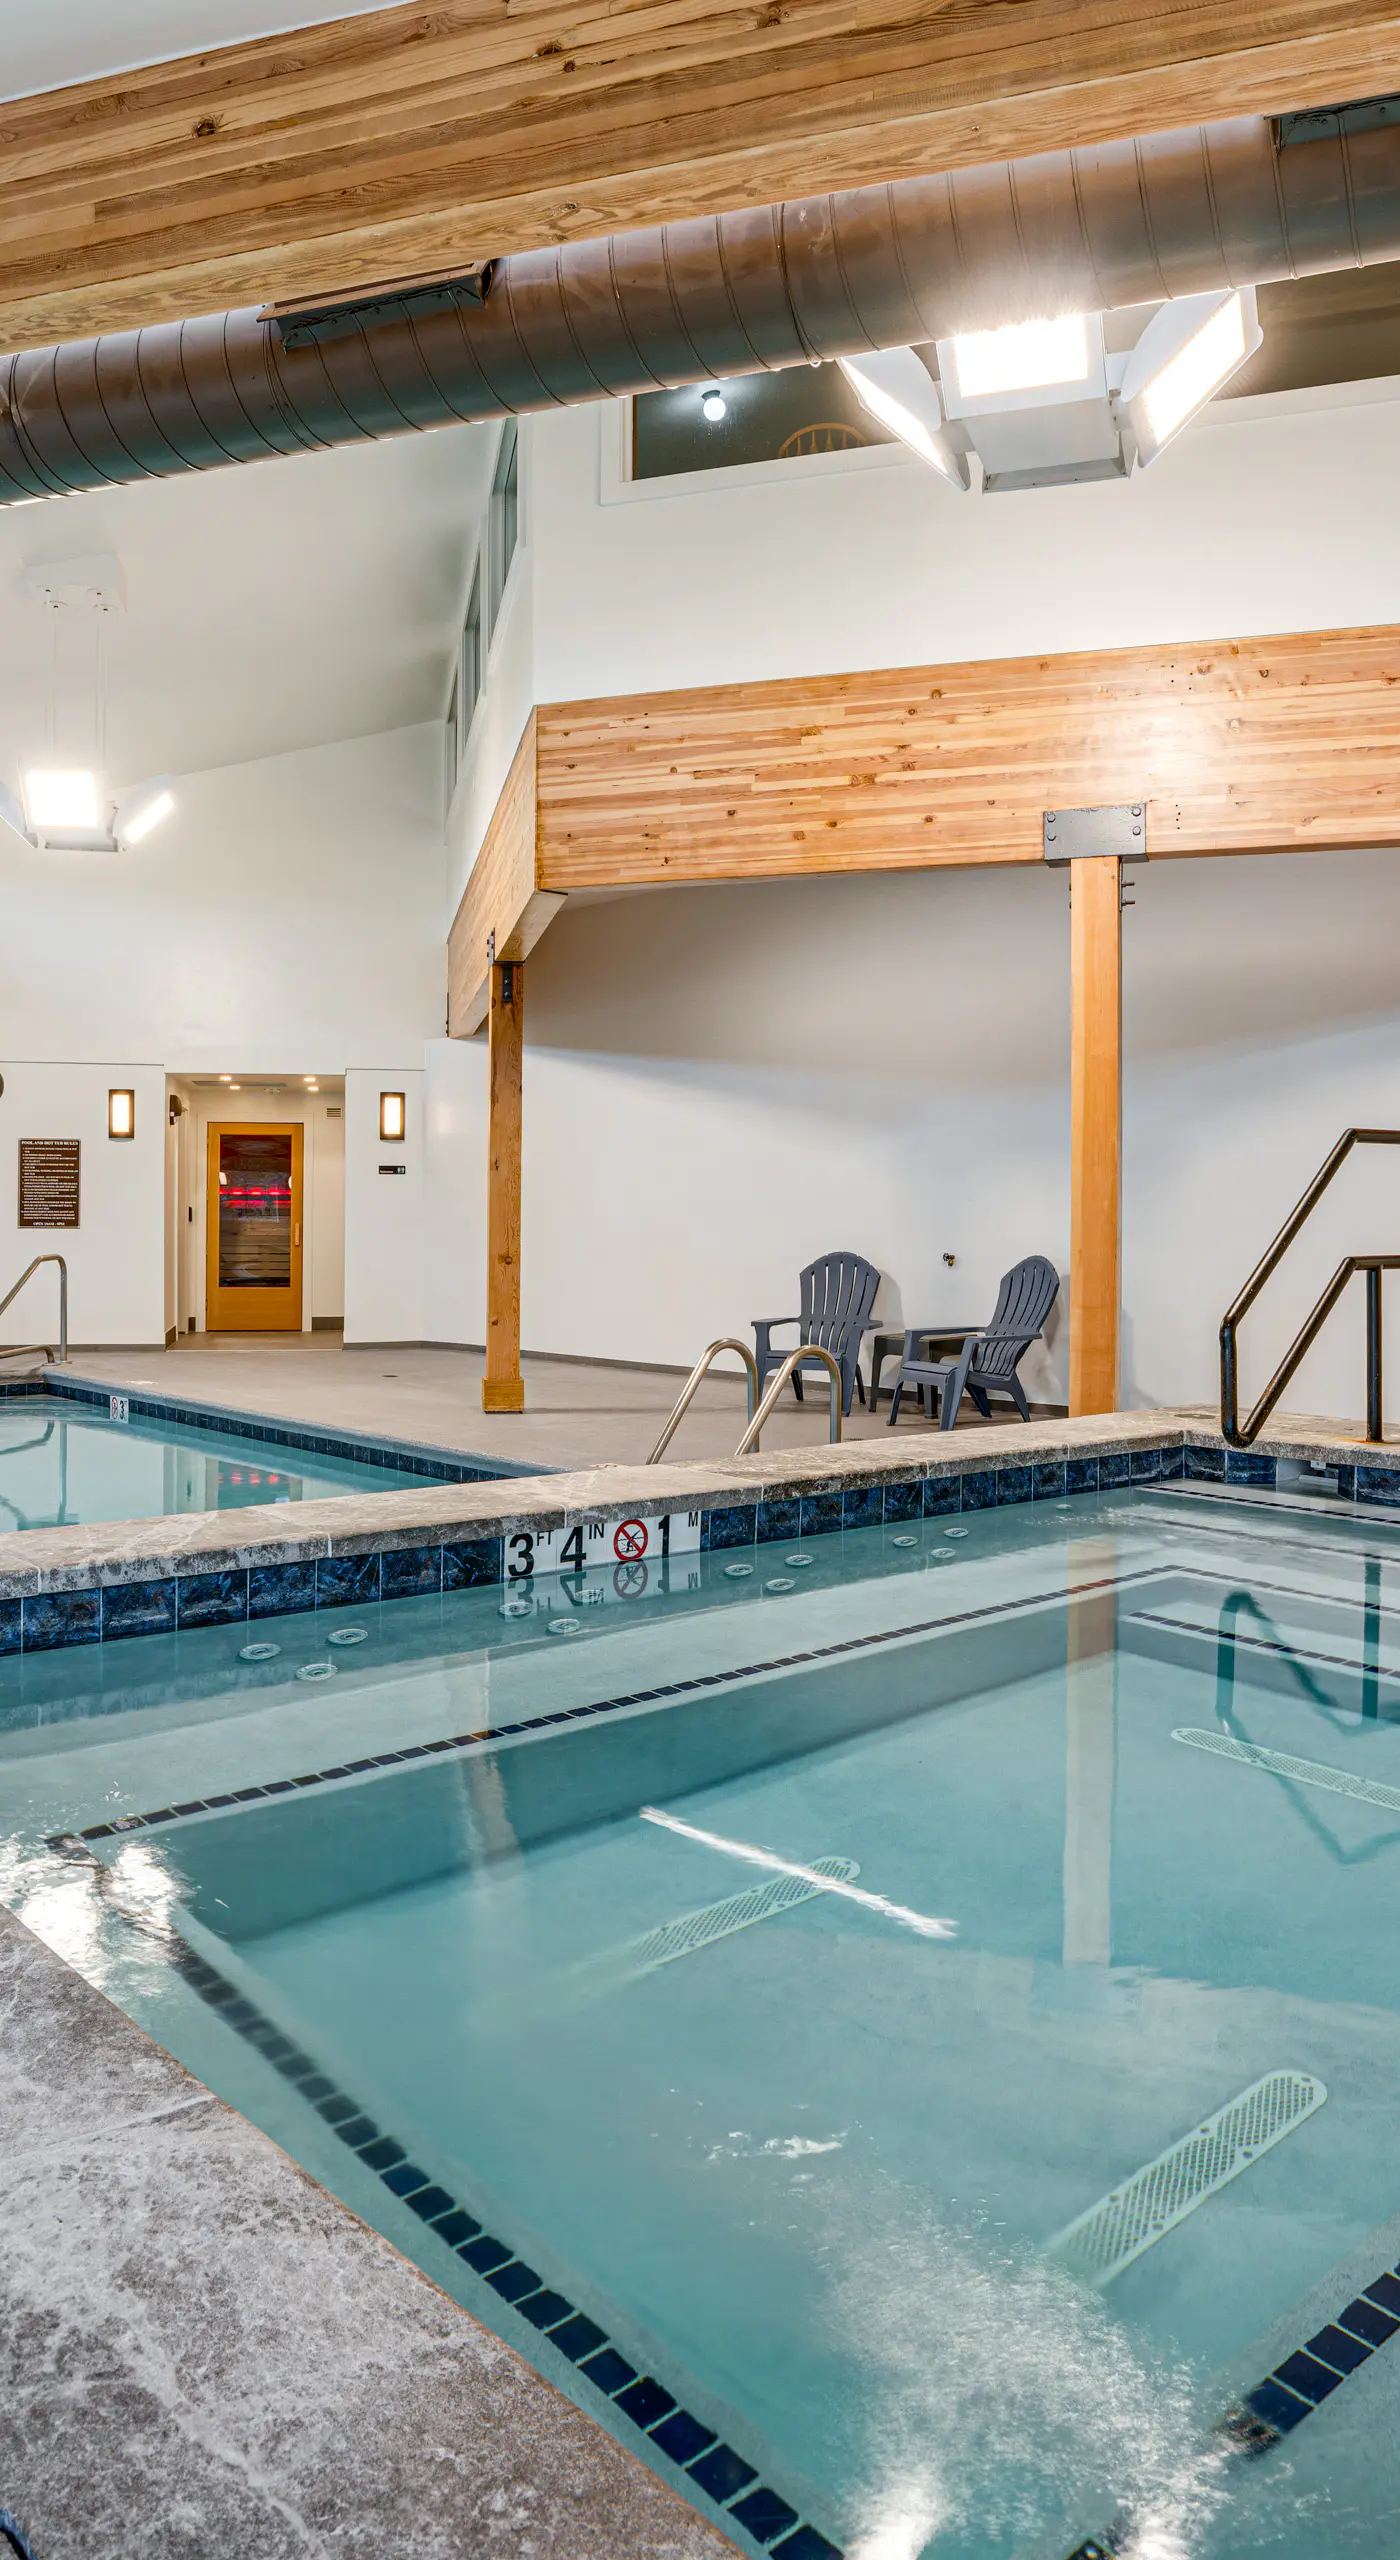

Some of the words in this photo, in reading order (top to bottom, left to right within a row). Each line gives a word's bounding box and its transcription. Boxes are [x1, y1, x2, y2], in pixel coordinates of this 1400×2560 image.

[508, 1533, 534, 1577] 3
[560, 1526, 587, 1572] 4
[589, 1523, 605, 1540] IN
[658, 1515, 671, 1558] 1
[688, 1512, 699, 1527] M
